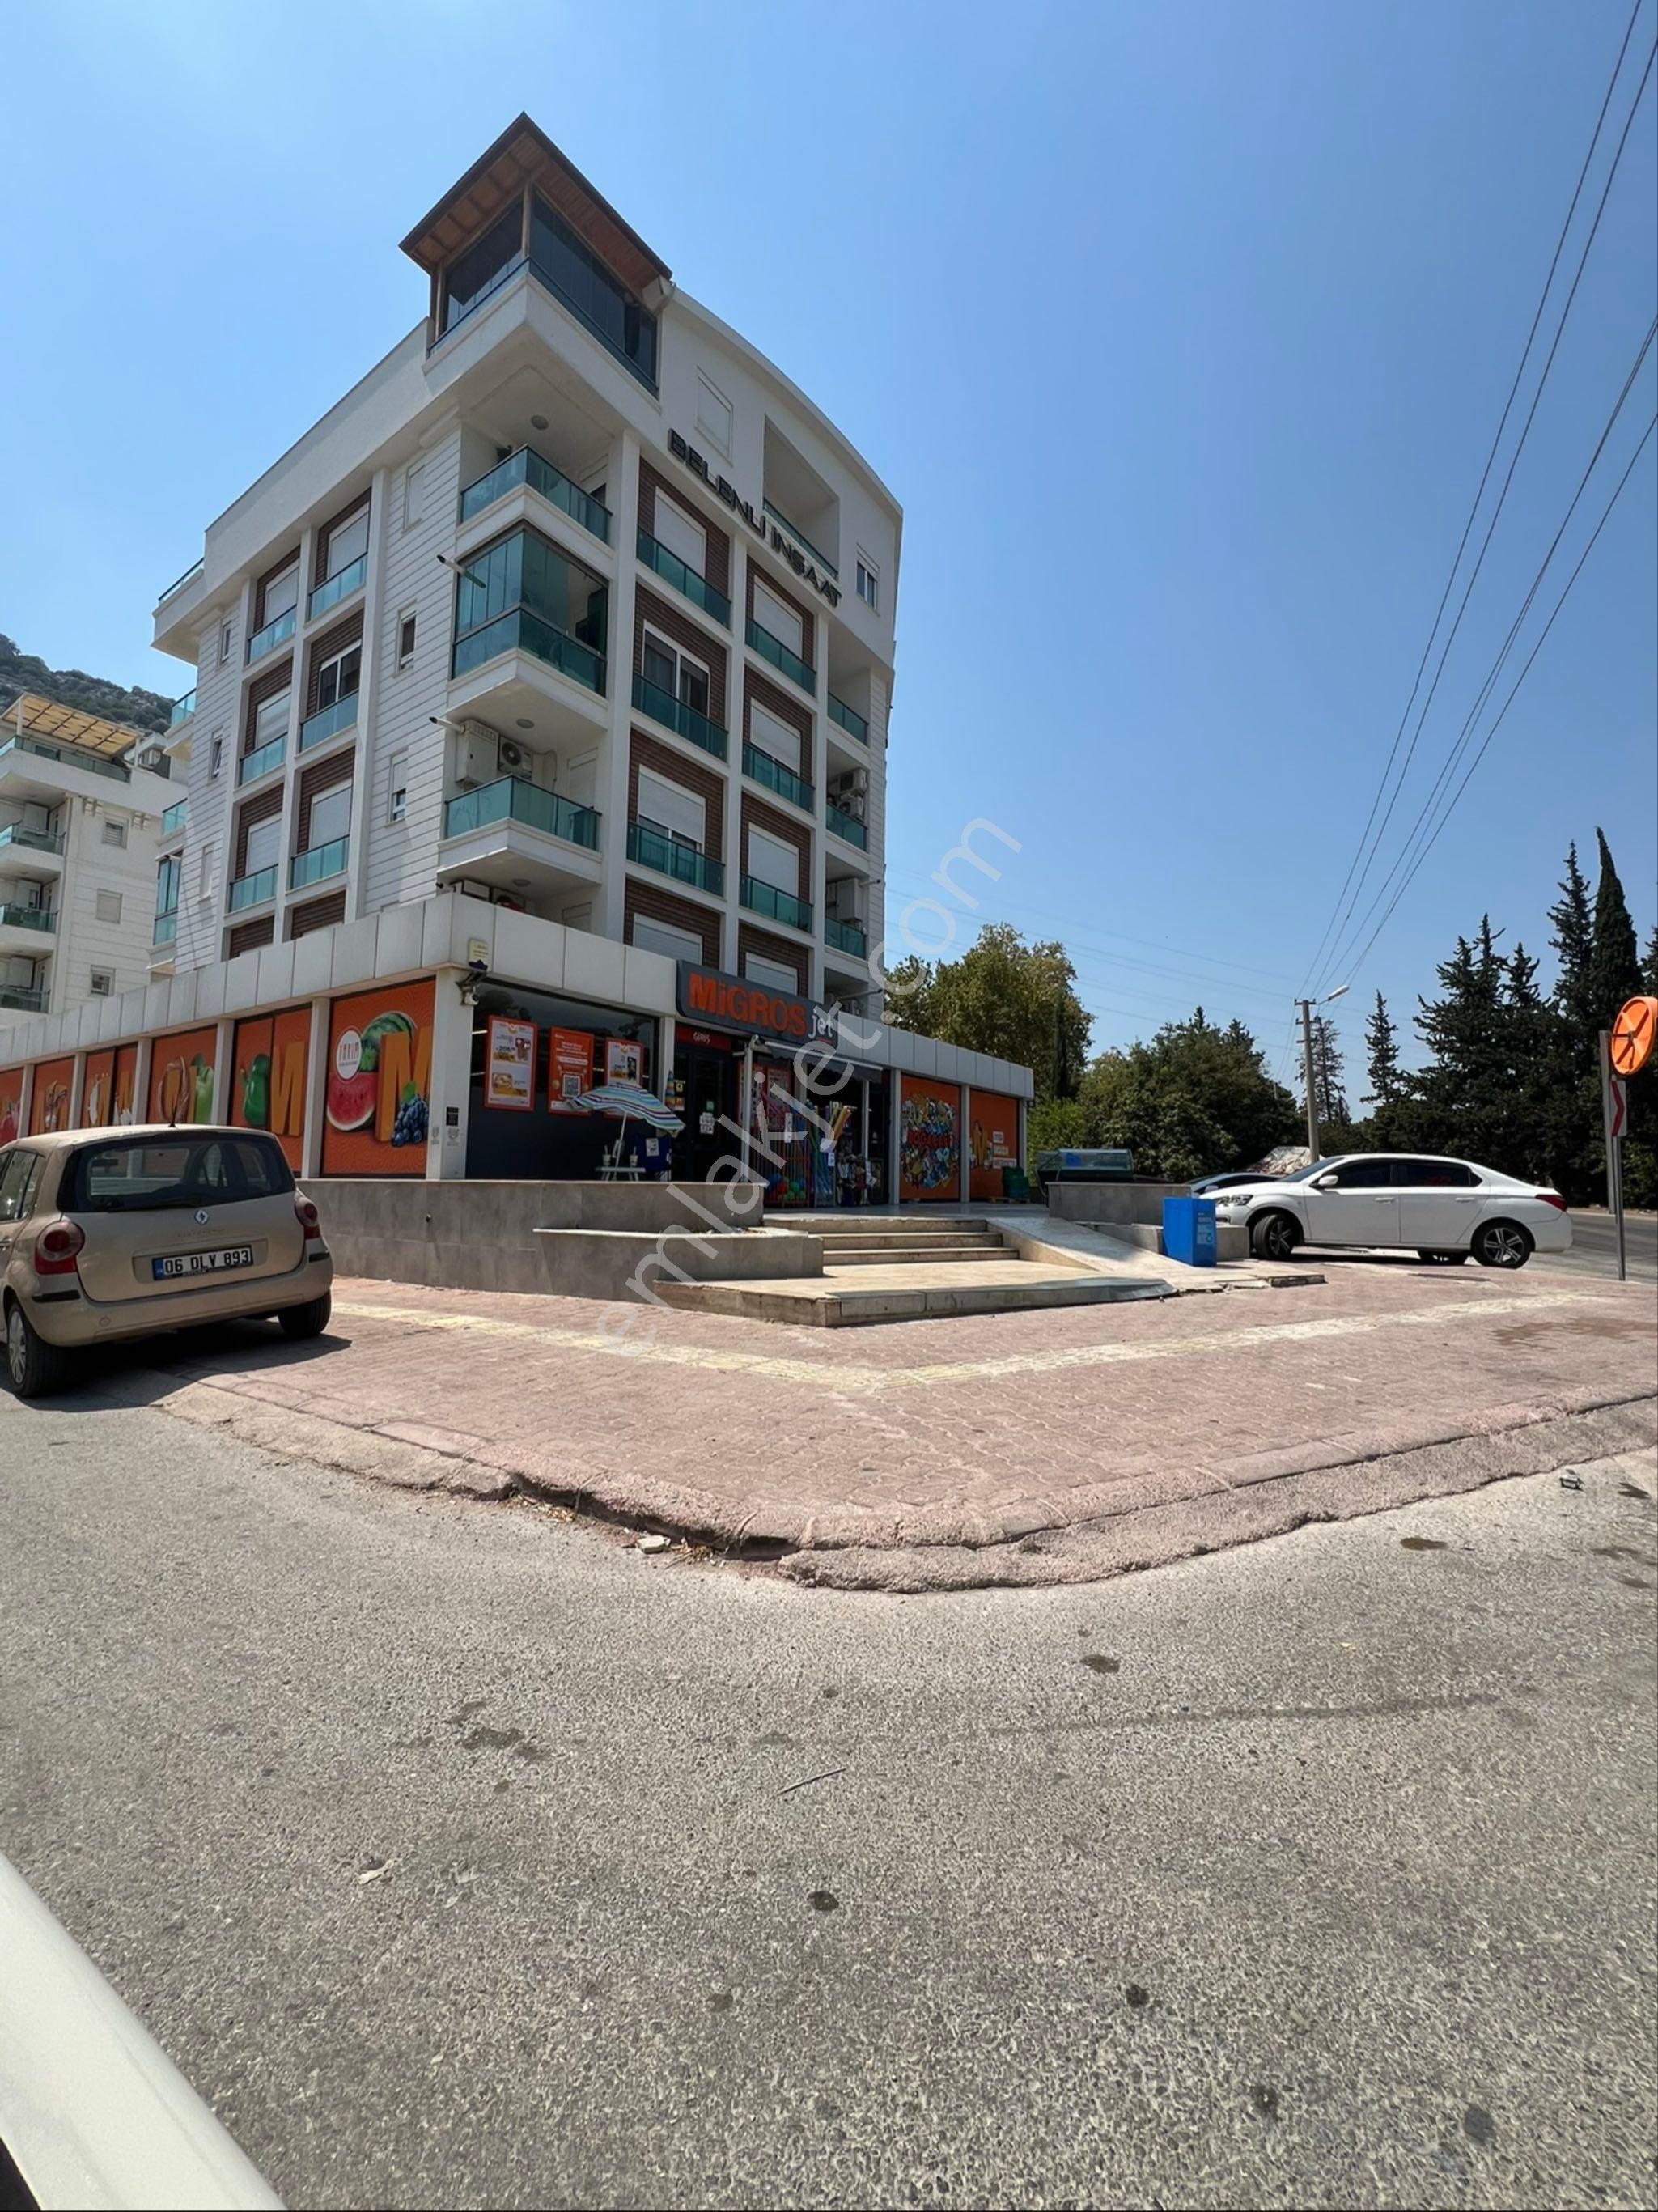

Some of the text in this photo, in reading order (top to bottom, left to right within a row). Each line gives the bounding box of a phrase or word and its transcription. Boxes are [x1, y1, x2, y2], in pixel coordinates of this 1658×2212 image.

[164, 1250, 249, 1274] 06 DLV 893
